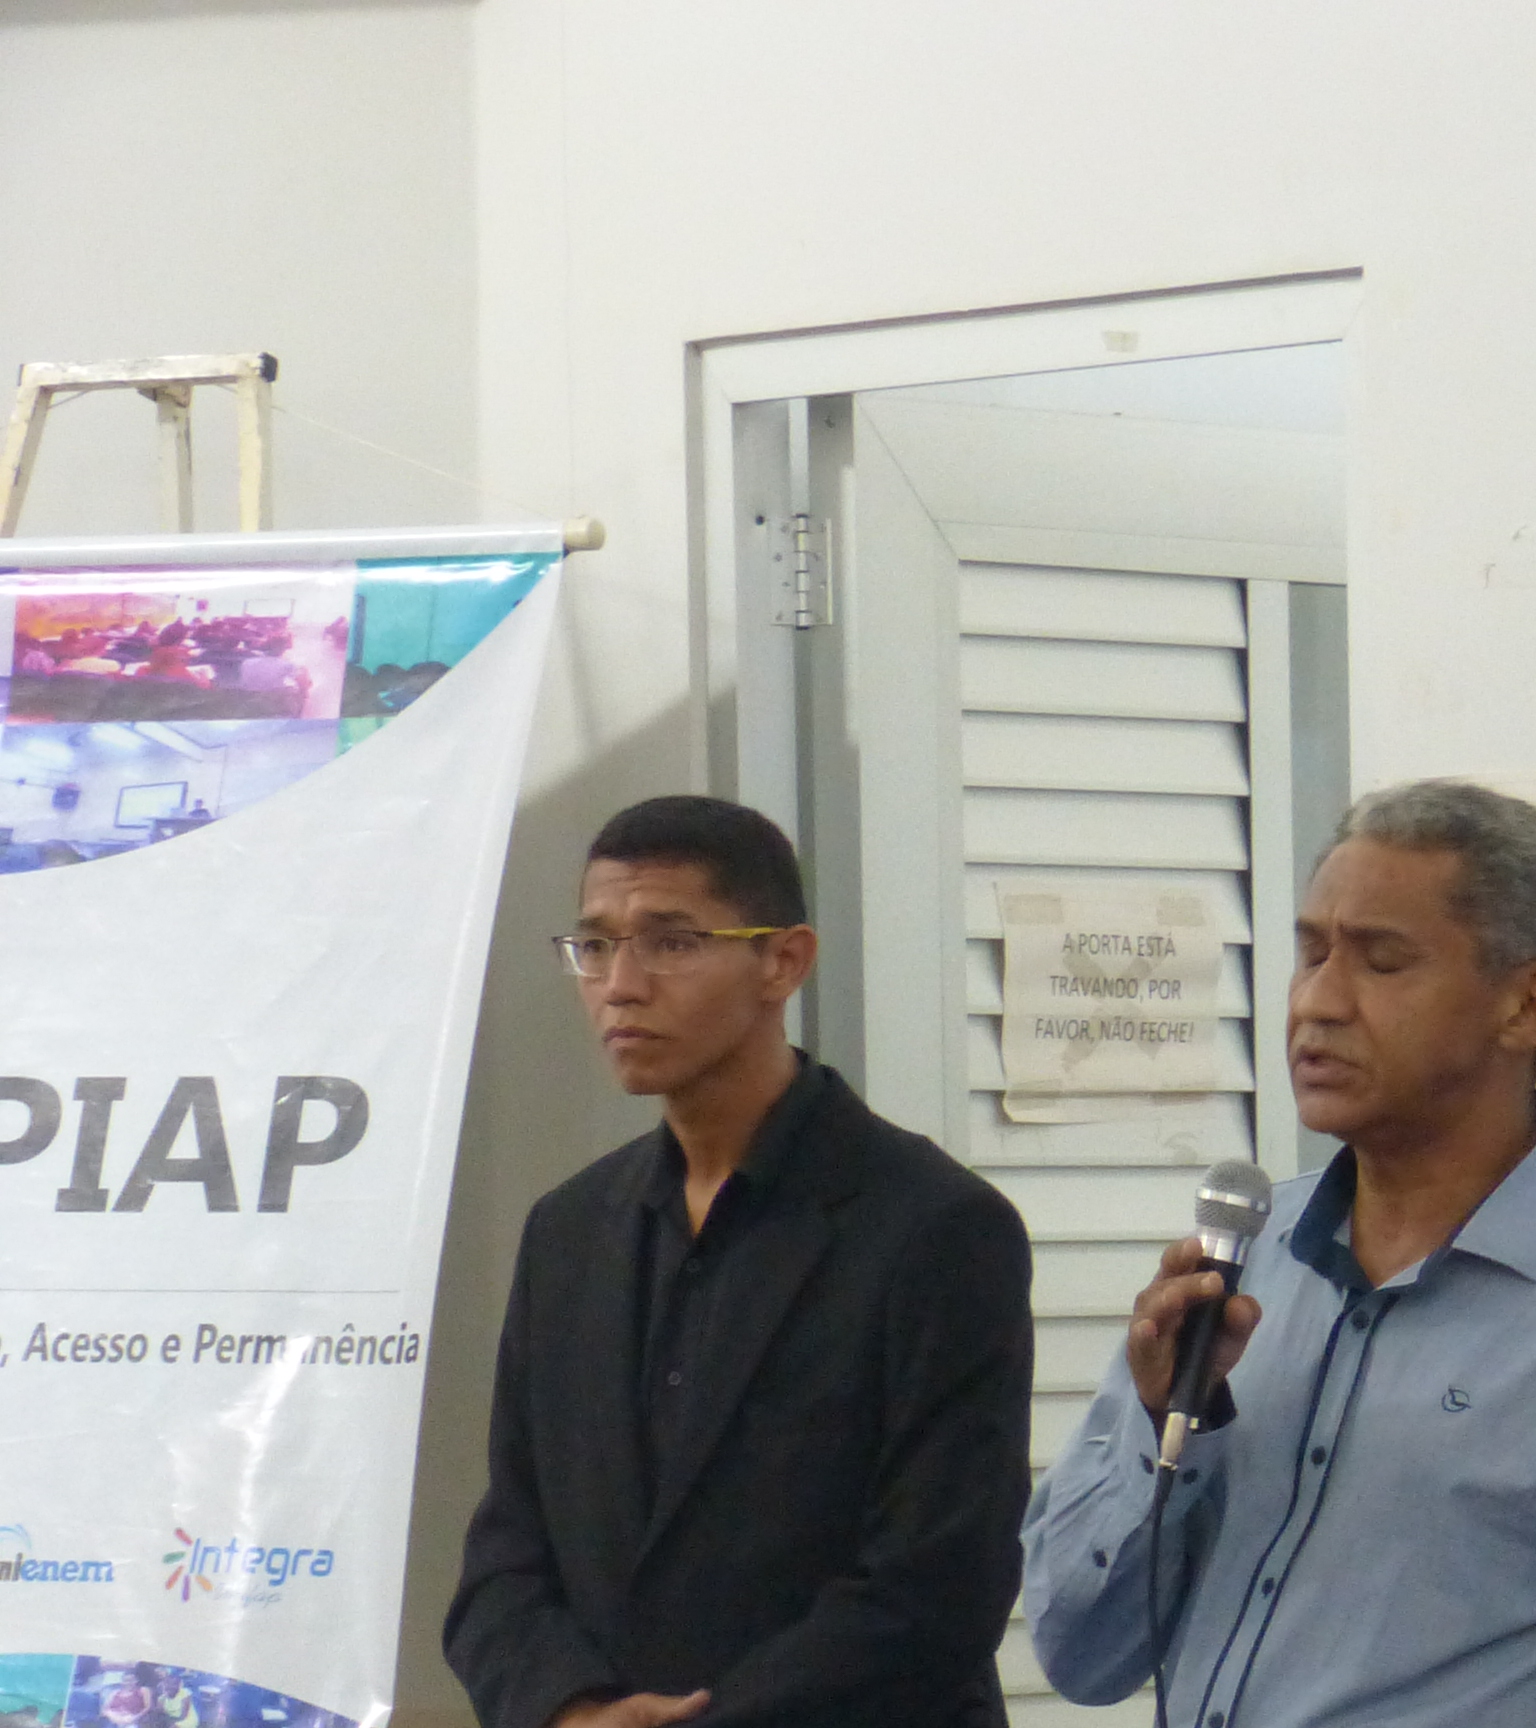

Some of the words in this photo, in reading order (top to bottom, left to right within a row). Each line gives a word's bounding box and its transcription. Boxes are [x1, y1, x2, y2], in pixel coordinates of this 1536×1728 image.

[1062, 932, 1072, 952] A
[1078, 933, 1132, 956] PORTA
[1137, 932, 1176, 957] ESTÁ
[1050, 975, 1144, 1003] TRAVANDO,
[1148, 979, 1182, 1000] POR
[1035, 1018, 1095, 1043] FAVOR,
[1100, 1016, 1134, 1042] NÃO
[1139, 1022, 1195, 1043] FECHE!
[22, 1322, 148, 1364] Acesso
[160, 1333, 181, 1364] e
[193, 1323, 420, 1365] Permnência
[189, 1537, 335, 1587] Integra
